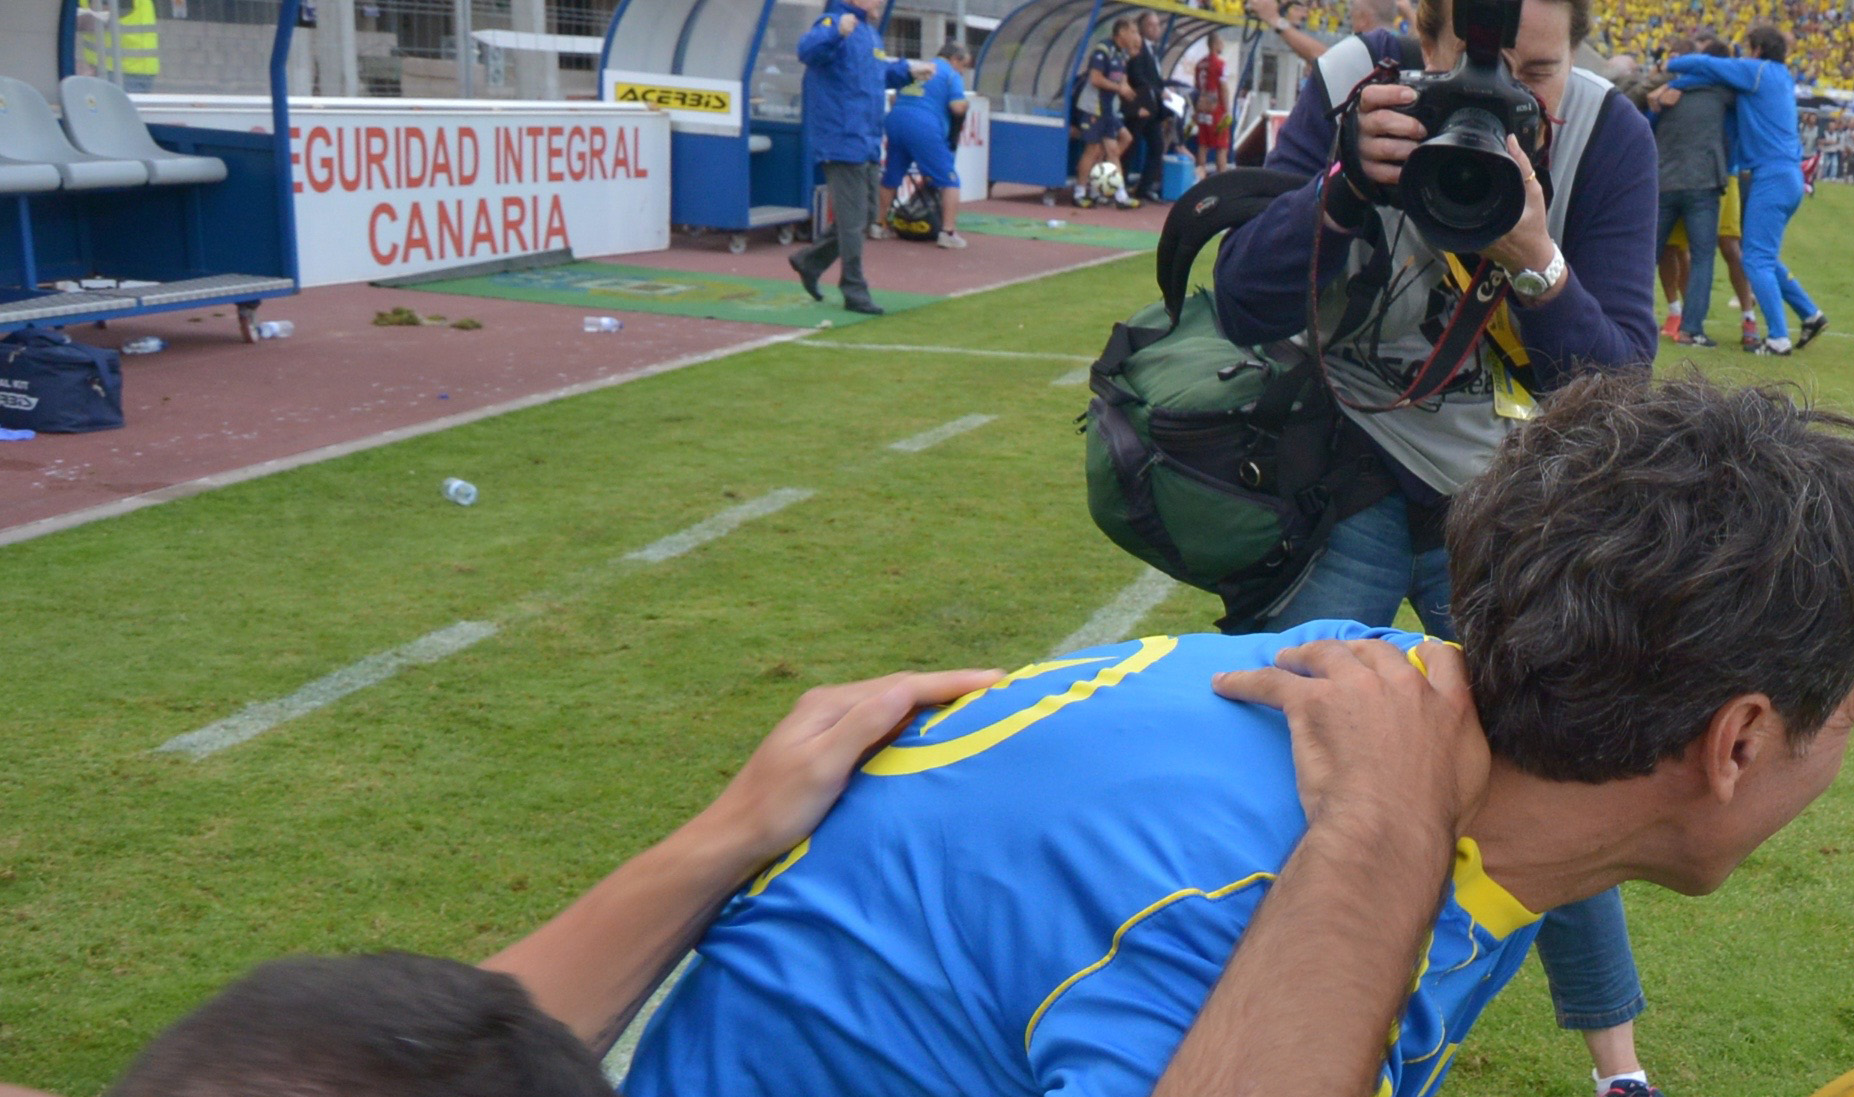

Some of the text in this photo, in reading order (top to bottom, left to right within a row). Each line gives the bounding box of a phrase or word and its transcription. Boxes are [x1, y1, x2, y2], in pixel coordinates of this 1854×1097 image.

[288, 125, 648, 194] EGURIDAD INTEGRAL
[367, 193, 571, 267] CANARIA
